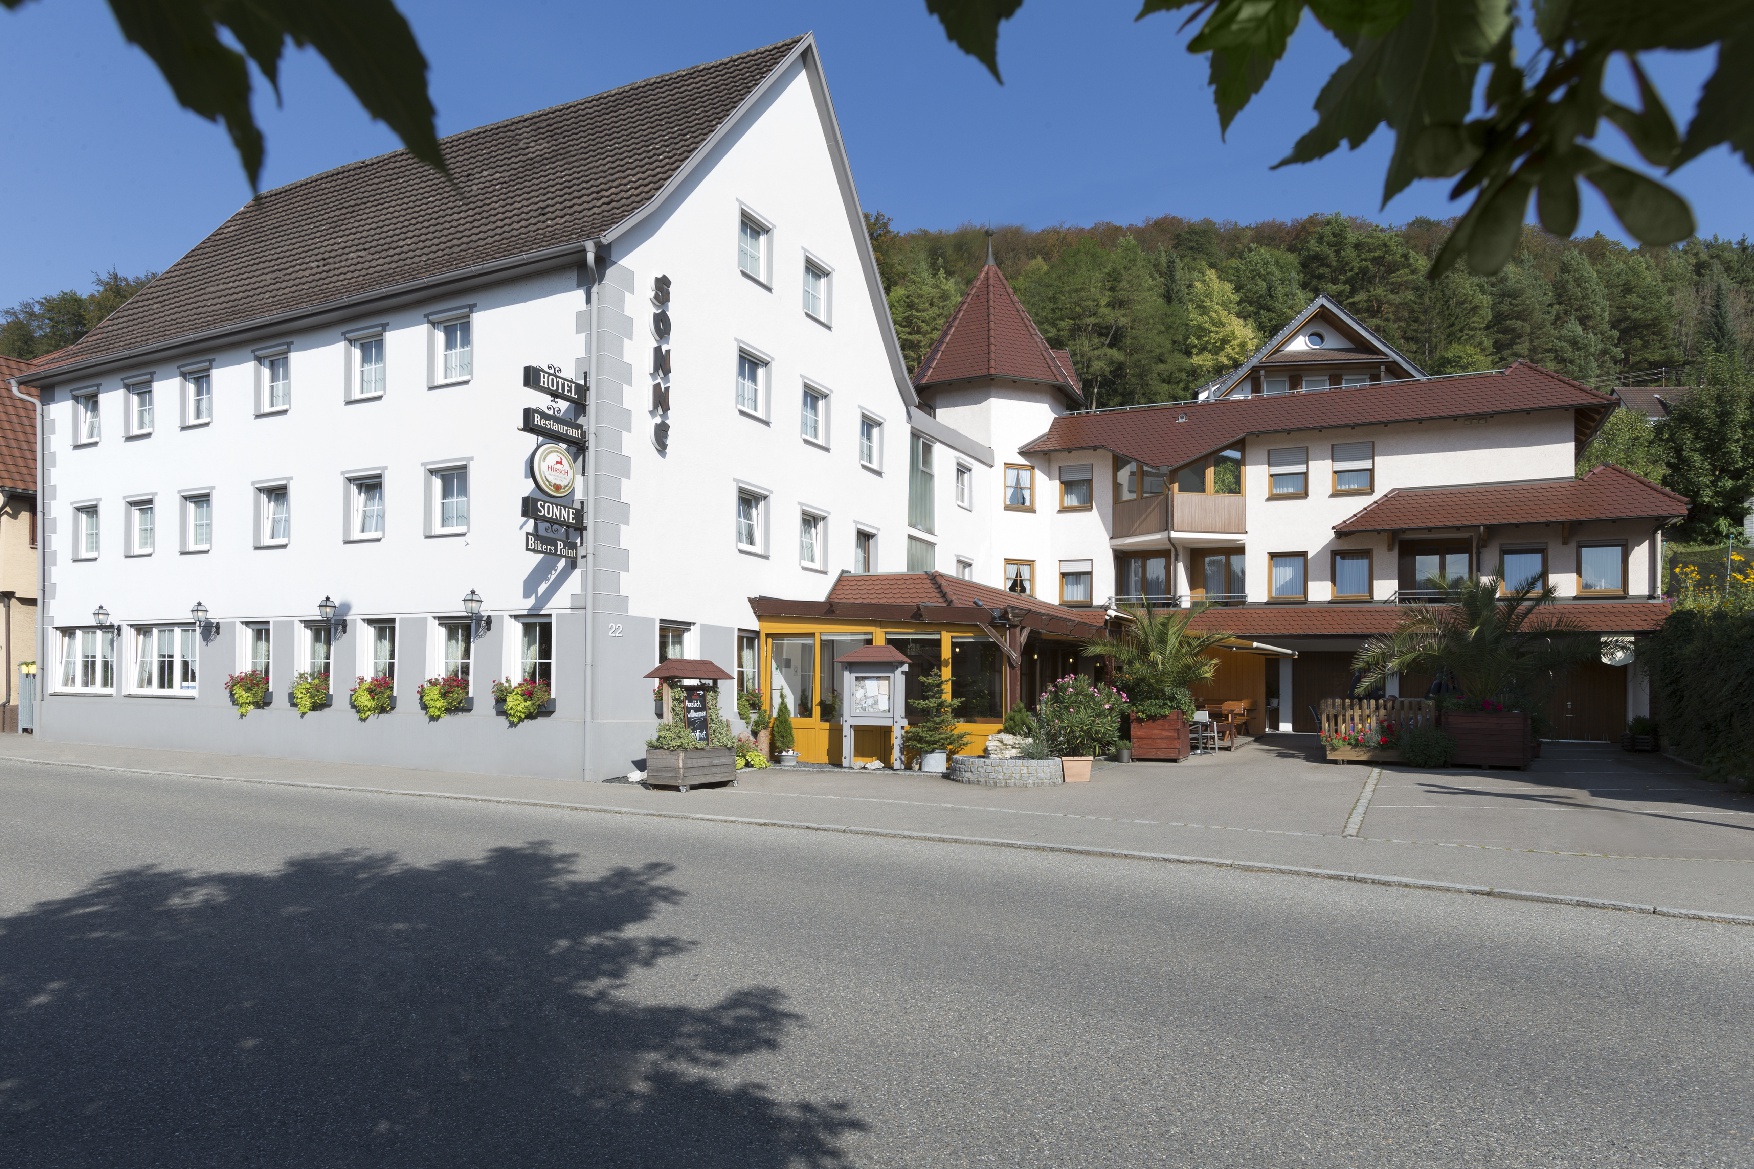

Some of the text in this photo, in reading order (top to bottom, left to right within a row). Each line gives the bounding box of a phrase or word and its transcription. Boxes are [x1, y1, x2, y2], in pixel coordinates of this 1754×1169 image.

[650, 274, 671, 450] SONNE
[540, 371, 578, 399] HOTEL
[534, 413, 582, 439] Restaurant
[537, 501, 576, 524] SONNE
[527, 534, 577, 558] Bikers Point
[608, 623, 623, 637] 22
